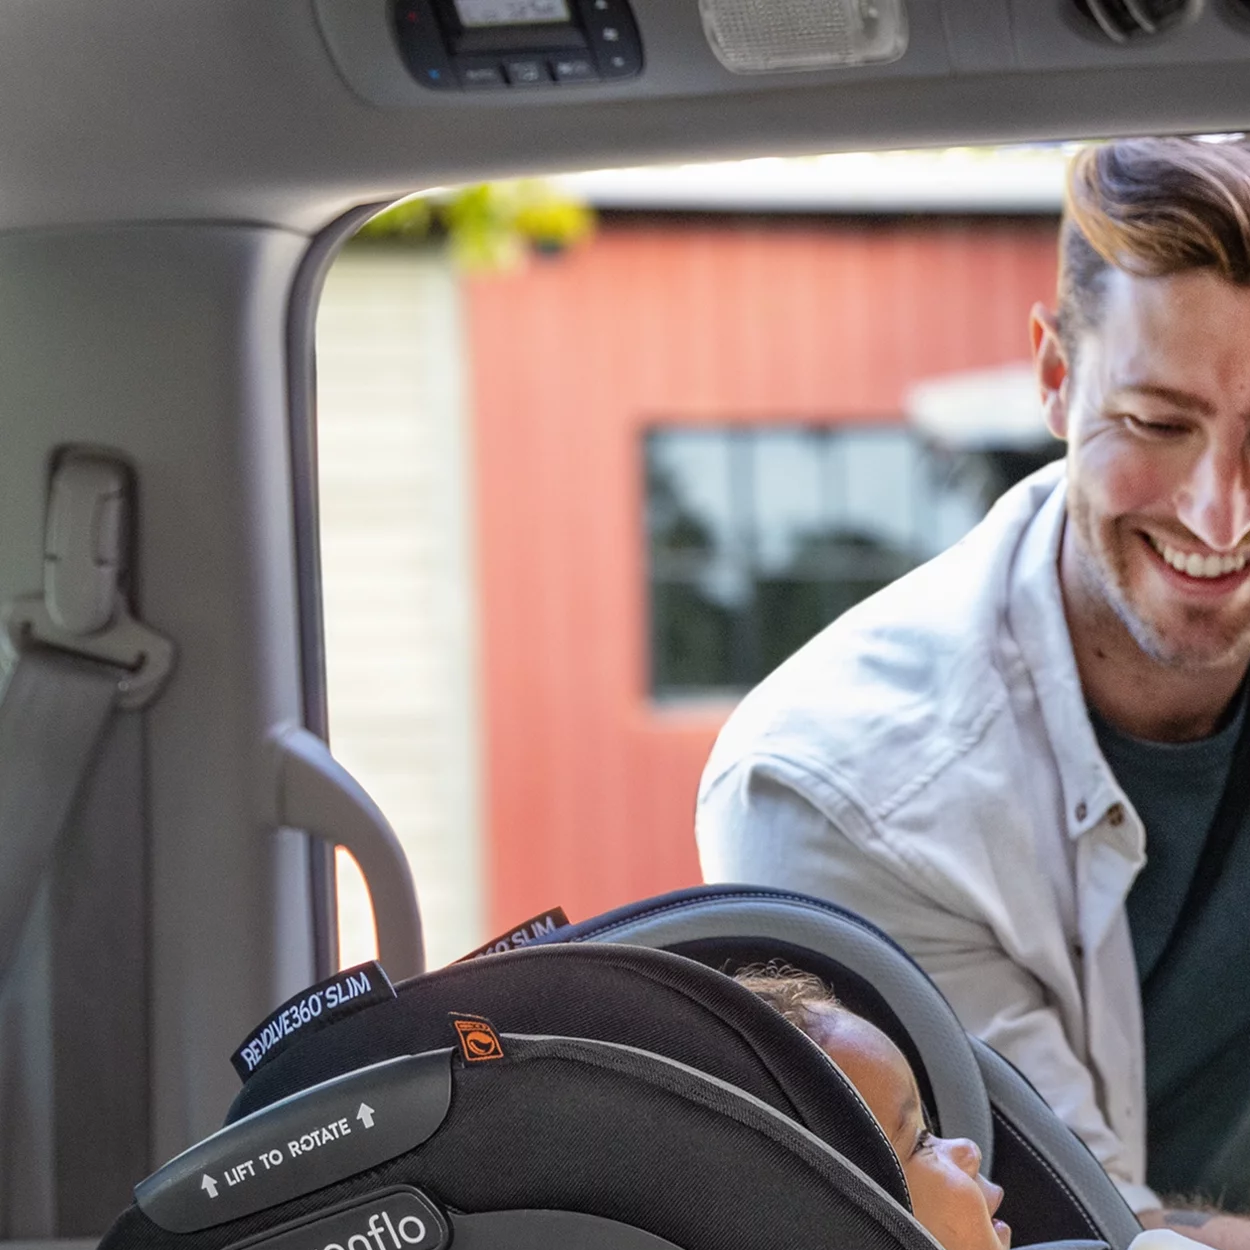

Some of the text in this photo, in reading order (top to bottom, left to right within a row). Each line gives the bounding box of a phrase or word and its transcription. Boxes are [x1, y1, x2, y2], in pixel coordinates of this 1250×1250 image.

[511, 916, 555, 946] SLIM
[325, 972, 371, 1008] SLIM
[224, 1118, 351, 1186] LIFT TO ROTATE
